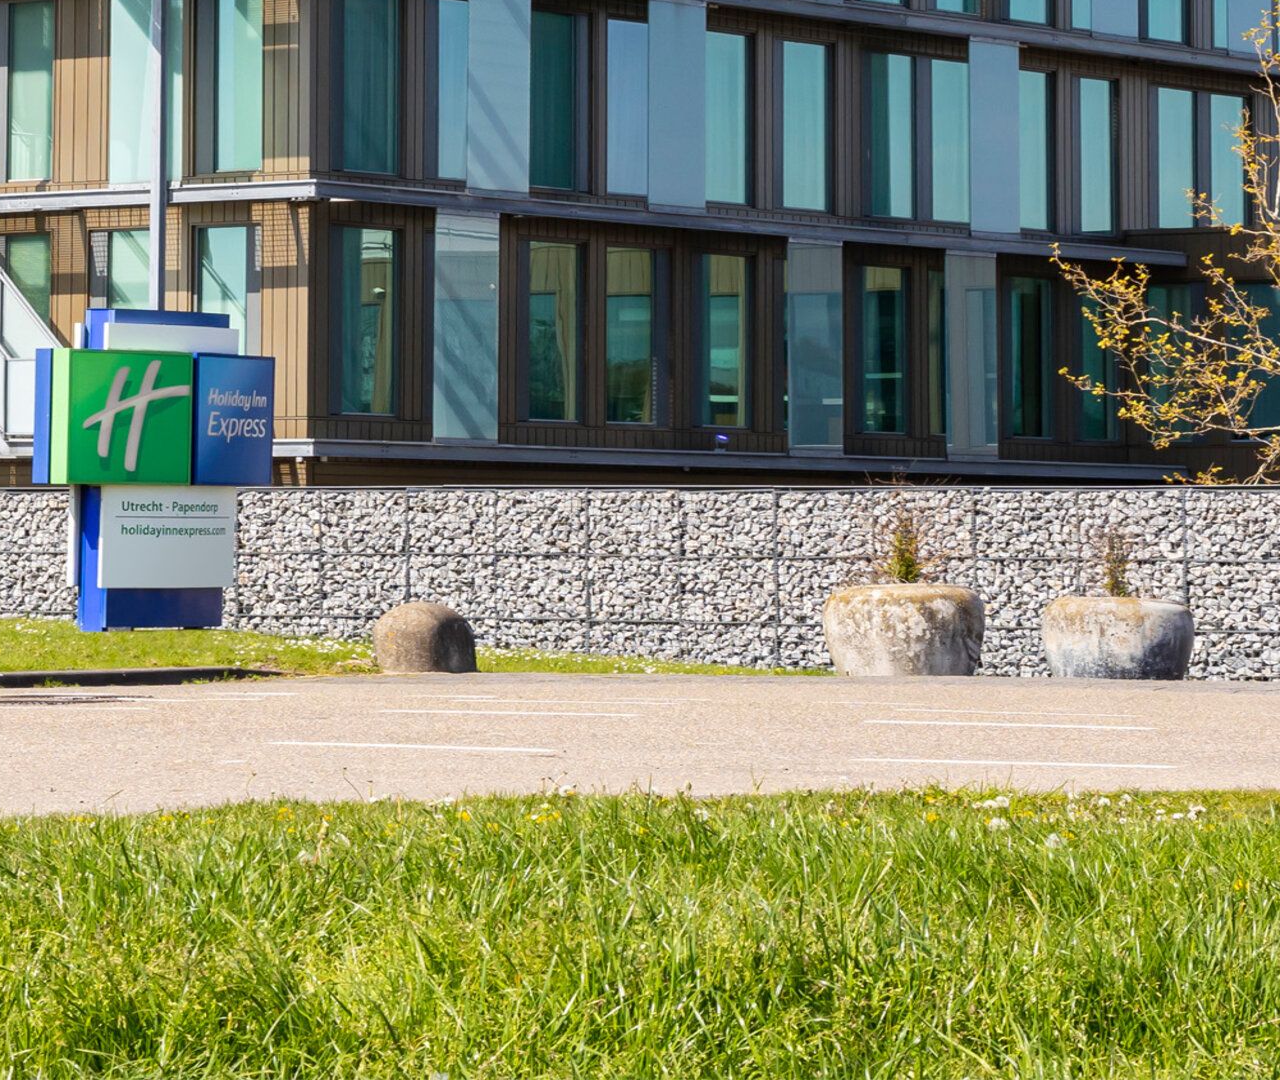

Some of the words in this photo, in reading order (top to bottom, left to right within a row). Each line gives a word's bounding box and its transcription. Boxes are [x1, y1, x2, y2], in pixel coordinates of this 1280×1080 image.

[208, 387, 252, 411] Holiday
[252, 389, 267, 408] Inn
[207, 410, 267, 444] Express
[121, 500, 163, 512] Utrecht
[172, 501, 219, 515] Papendorp
[120, 524, 227, 538] holidayinnexpress.com
